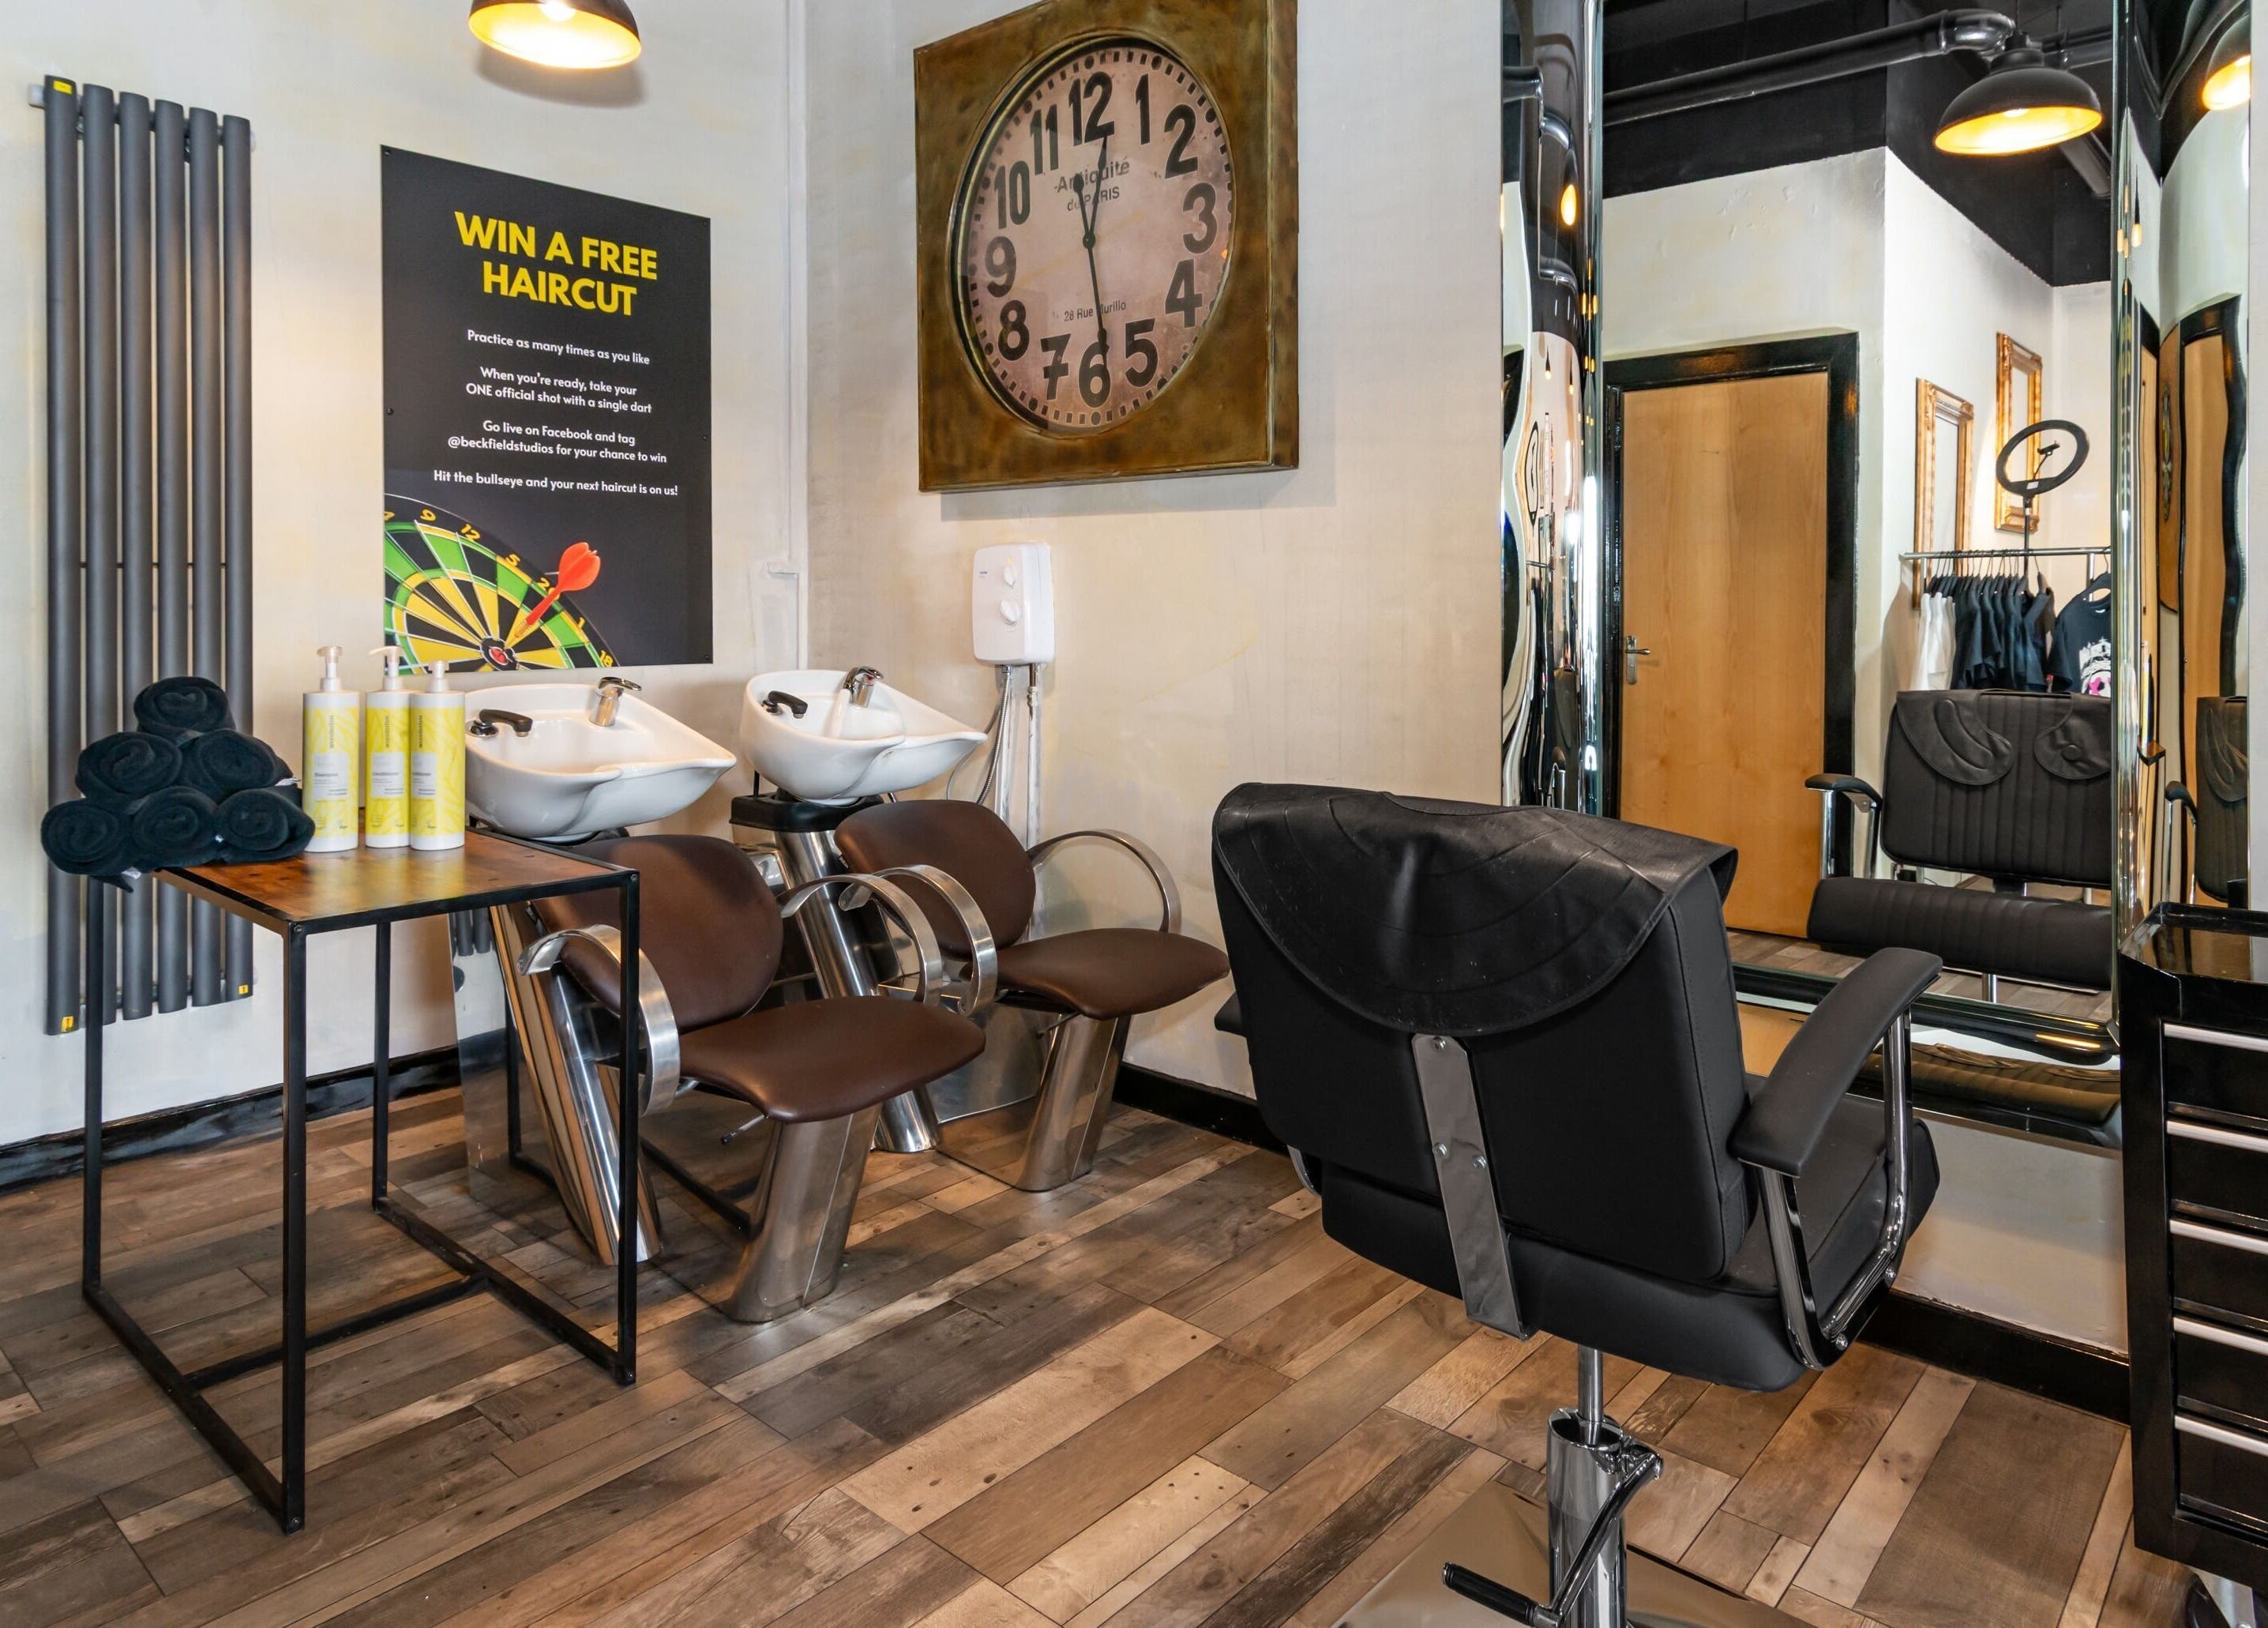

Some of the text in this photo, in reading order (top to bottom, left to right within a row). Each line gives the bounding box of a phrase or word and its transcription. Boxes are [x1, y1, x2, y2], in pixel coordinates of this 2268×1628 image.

[1068, 71, 1115, 147] 12
[1135, 73, 1151, 145] 1
[1030, 103, 1060, 175] 11
[1164, 104, 1199, 179] 2
[993, 160, 1031, 229] 10
[1054, 156, 1130, 194] Aiquité
[1084, 186, 1120, 205] PRIS
[454, 211, 658, 280] WIN A FREE
[1183, 182, 1218, 254] 3
[483, 261, 637, 316] HAIRCUT
[986, 235, 1016, 298] 9
[1165, 259, 1203, 329] 4
[997, 299, 1030, 361] 8
[1076, 308, 1094, 319] Rue
[467, 329, 650, 365] Practice as many times as you like
[1041, 333, 1072, 400] 7
[1079, 342, 1111, 408] 6
[1125, 318, 1158, 386] 5
[465, 382, 652, 413] ONE official shot with a single dart
[479, 366, 637, 397] When you're ready, take your
[447, 435, 667, 463] @beckfieldstudios for your chance to win
[483, 419, 636, 447] Go live on Facebook and tag
[434, 469, 452, 482] Hit
[452, 471, 474, 483] the
[475, 472, 524, 489] bullseye
[525, 476, 548, 488] and
[550, 480, 575, 491] your
[576, 481, 599, 491] next
[601, 480, 637, 493] haircut
[639, 483, 648, 494] is
[663, 485, 678, 496] us!
[460, 524, 481, 542] 12
[506, 554, 520, 567] 5
[600, 649, 614, 667] 18
